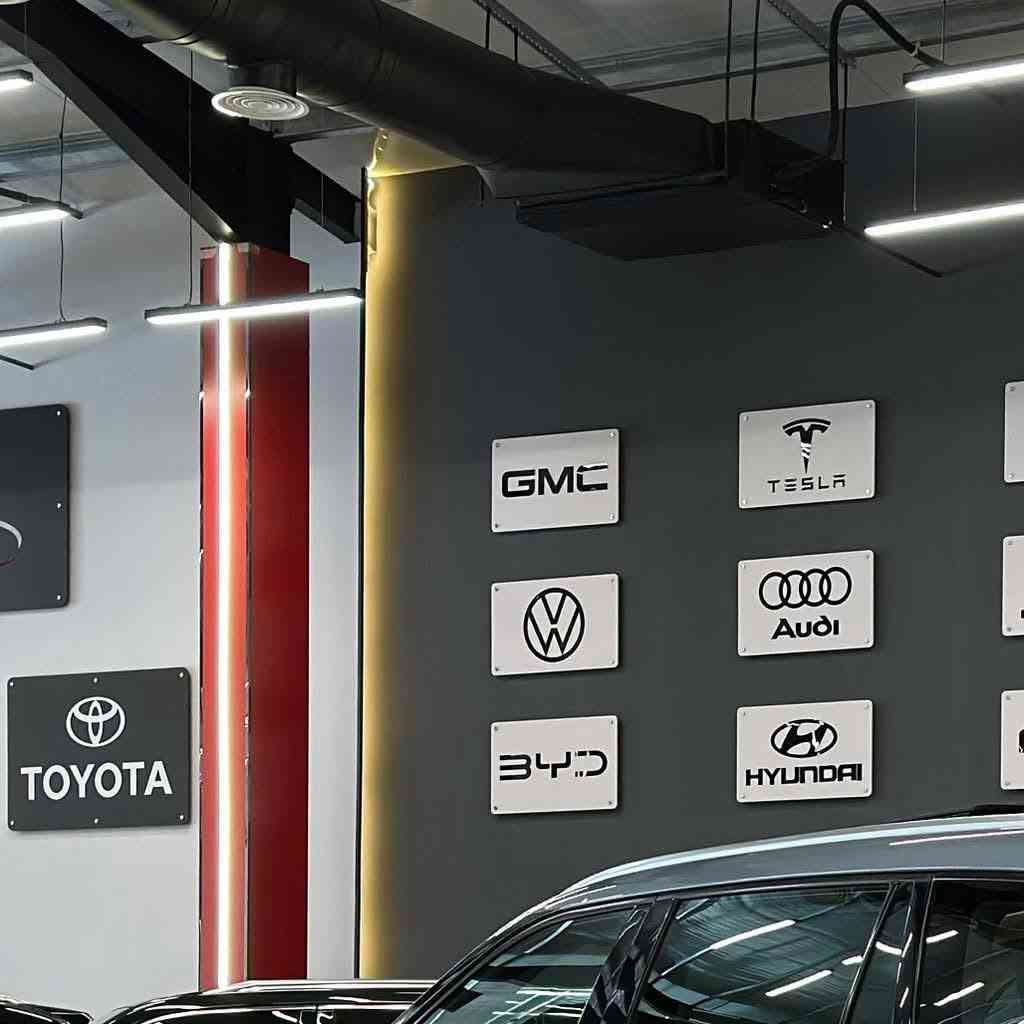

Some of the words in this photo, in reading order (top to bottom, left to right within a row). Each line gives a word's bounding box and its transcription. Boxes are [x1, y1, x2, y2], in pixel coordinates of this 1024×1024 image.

[501, 464, 609, 498] GMC
[767, 473, 846, 493] TESLA
[771, 615, 840, 640] Audi
[499, 750, 608, 781] BYD
[745, 763, 863, 787] HYUNDAI
[20, 760, 173, 801] TOYOTA
